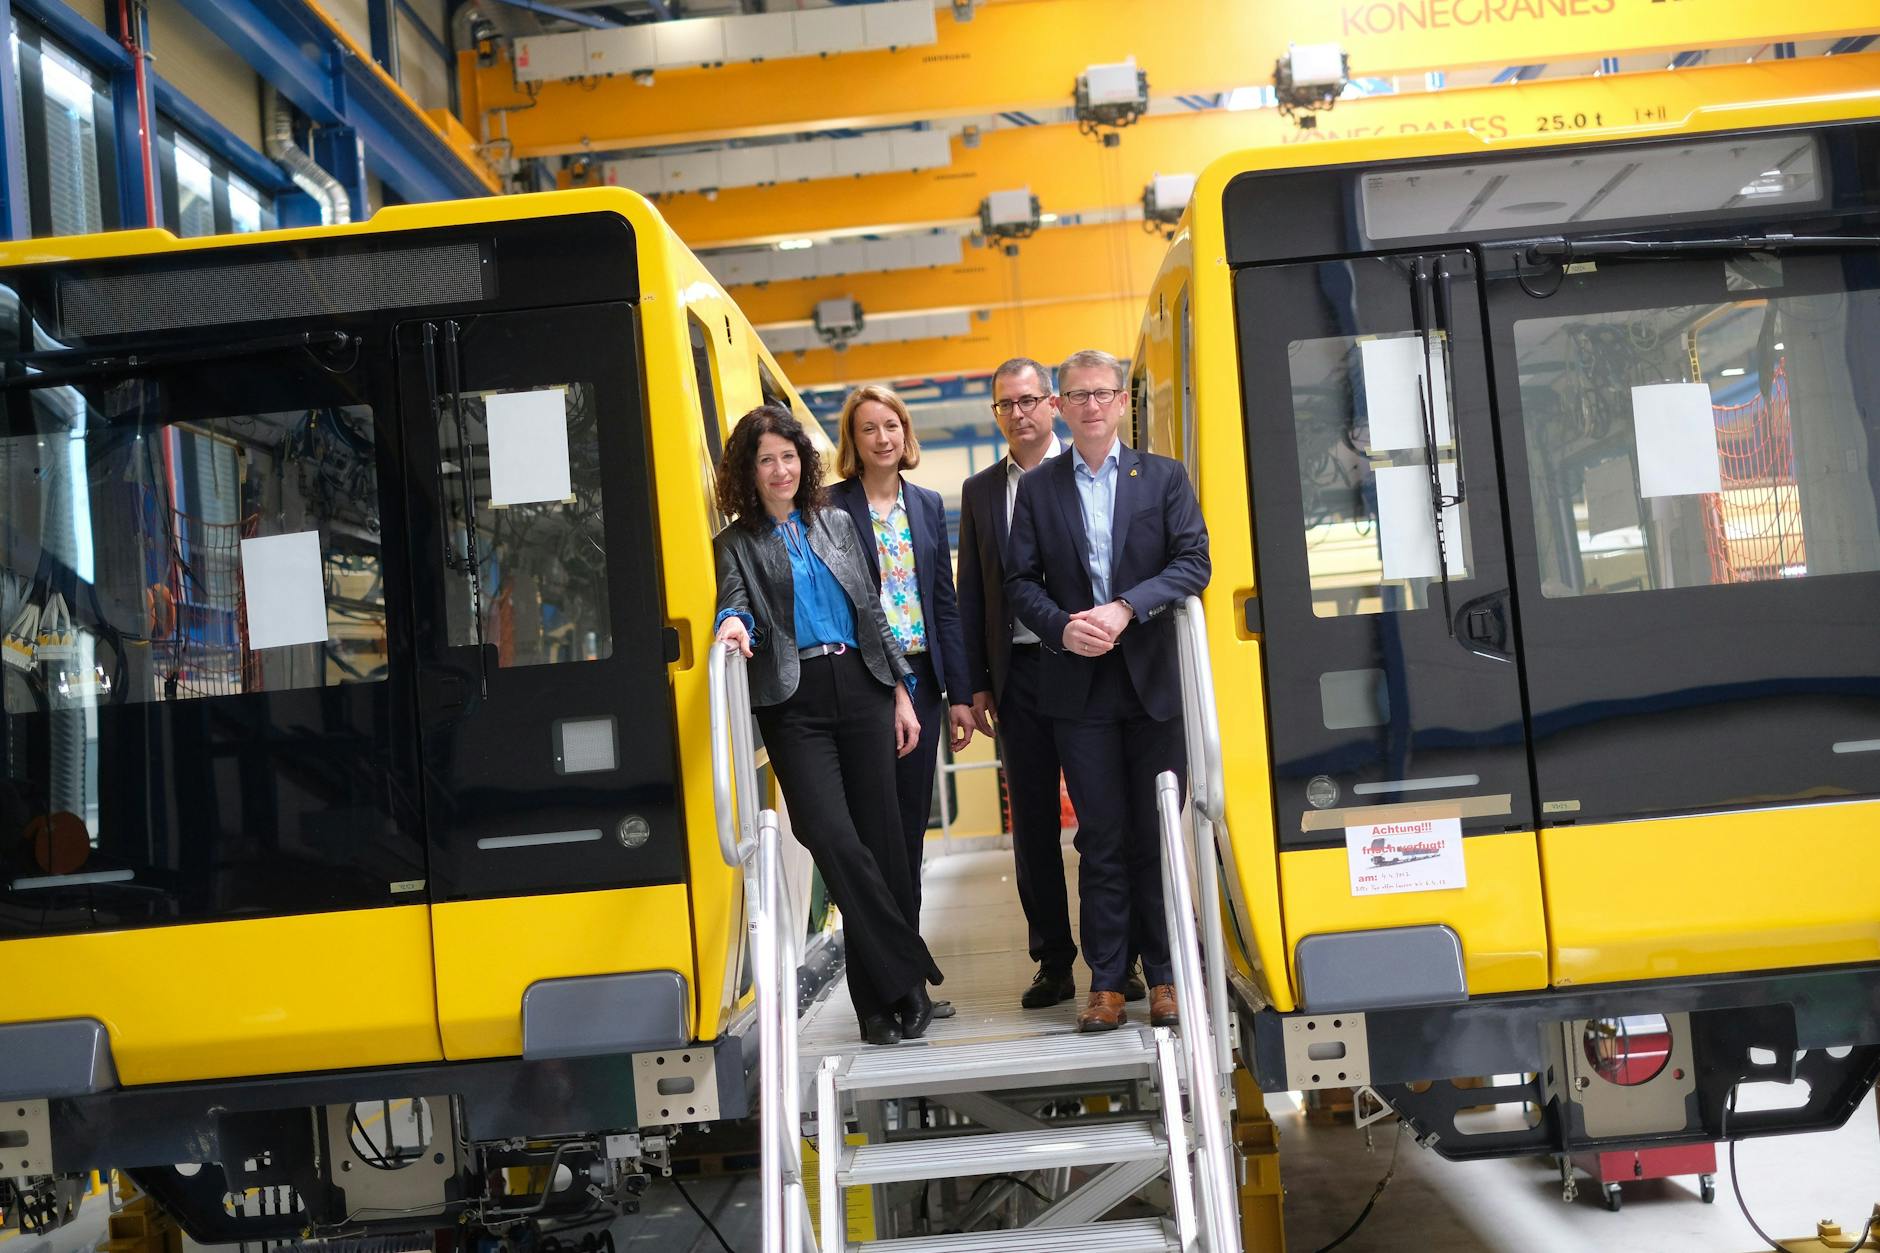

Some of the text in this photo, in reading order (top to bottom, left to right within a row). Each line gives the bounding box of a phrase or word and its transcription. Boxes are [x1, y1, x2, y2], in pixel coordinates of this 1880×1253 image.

[1537, 112, 1587, 132] 25.0
[1595, 112, 1602, 126] t
[1372, 822, 1432, 835] Achtung!!!
[1358, 874, 1378, 883] am:
